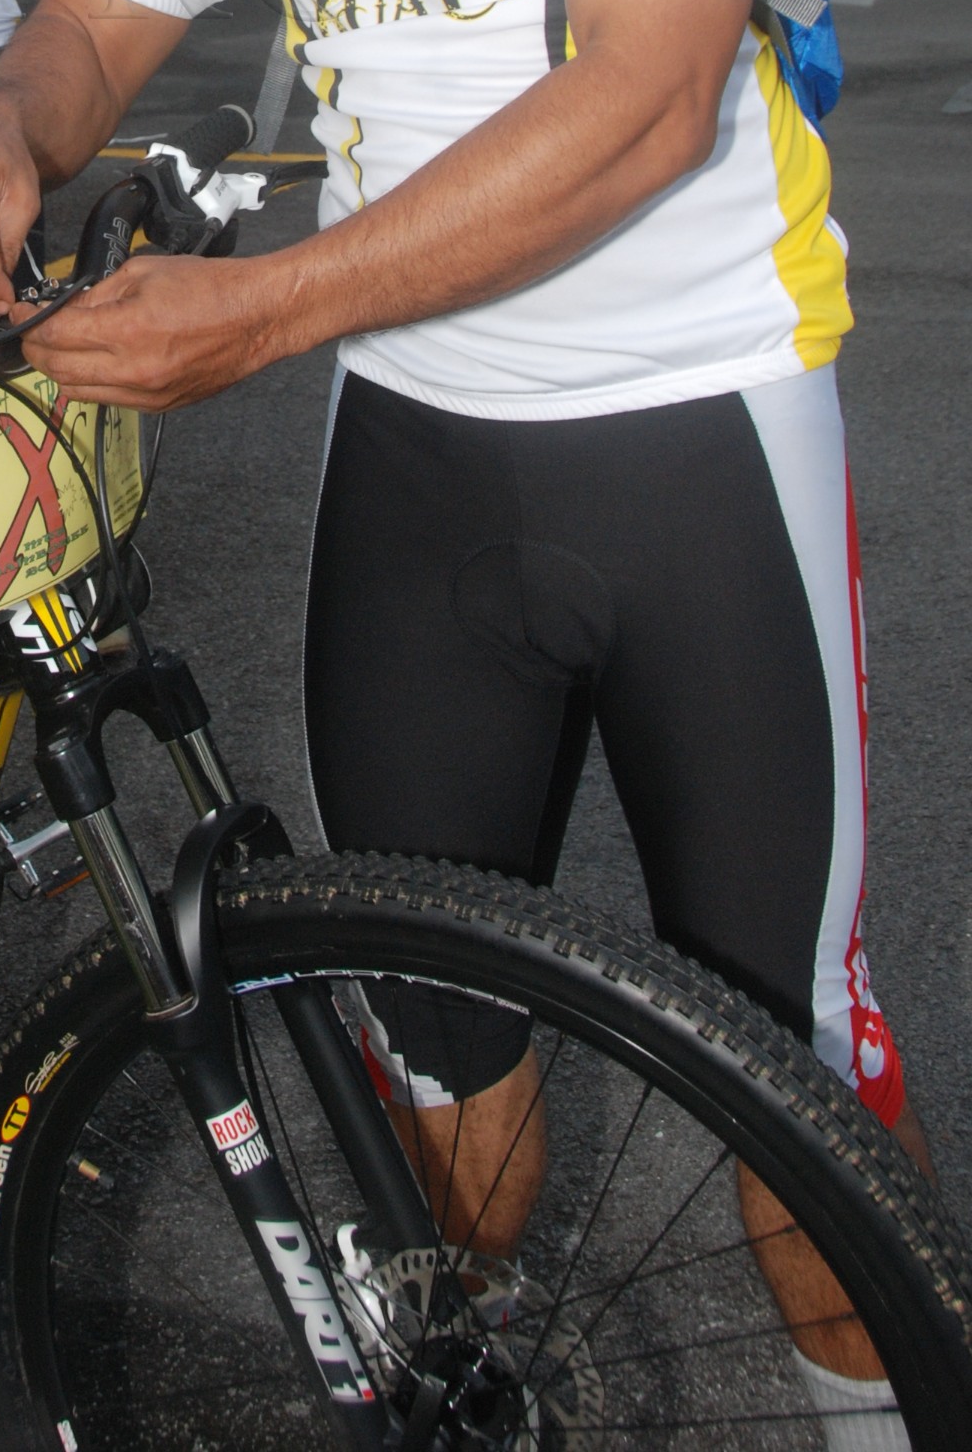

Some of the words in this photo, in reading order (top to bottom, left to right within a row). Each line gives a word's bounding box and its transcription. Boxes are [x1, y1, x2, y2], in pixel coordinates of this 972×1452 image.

[4, 1101, 28, 1132] TT
[212, 1104, 258, 1147] ROCK
[254, 1220, 366, 1376] DART
